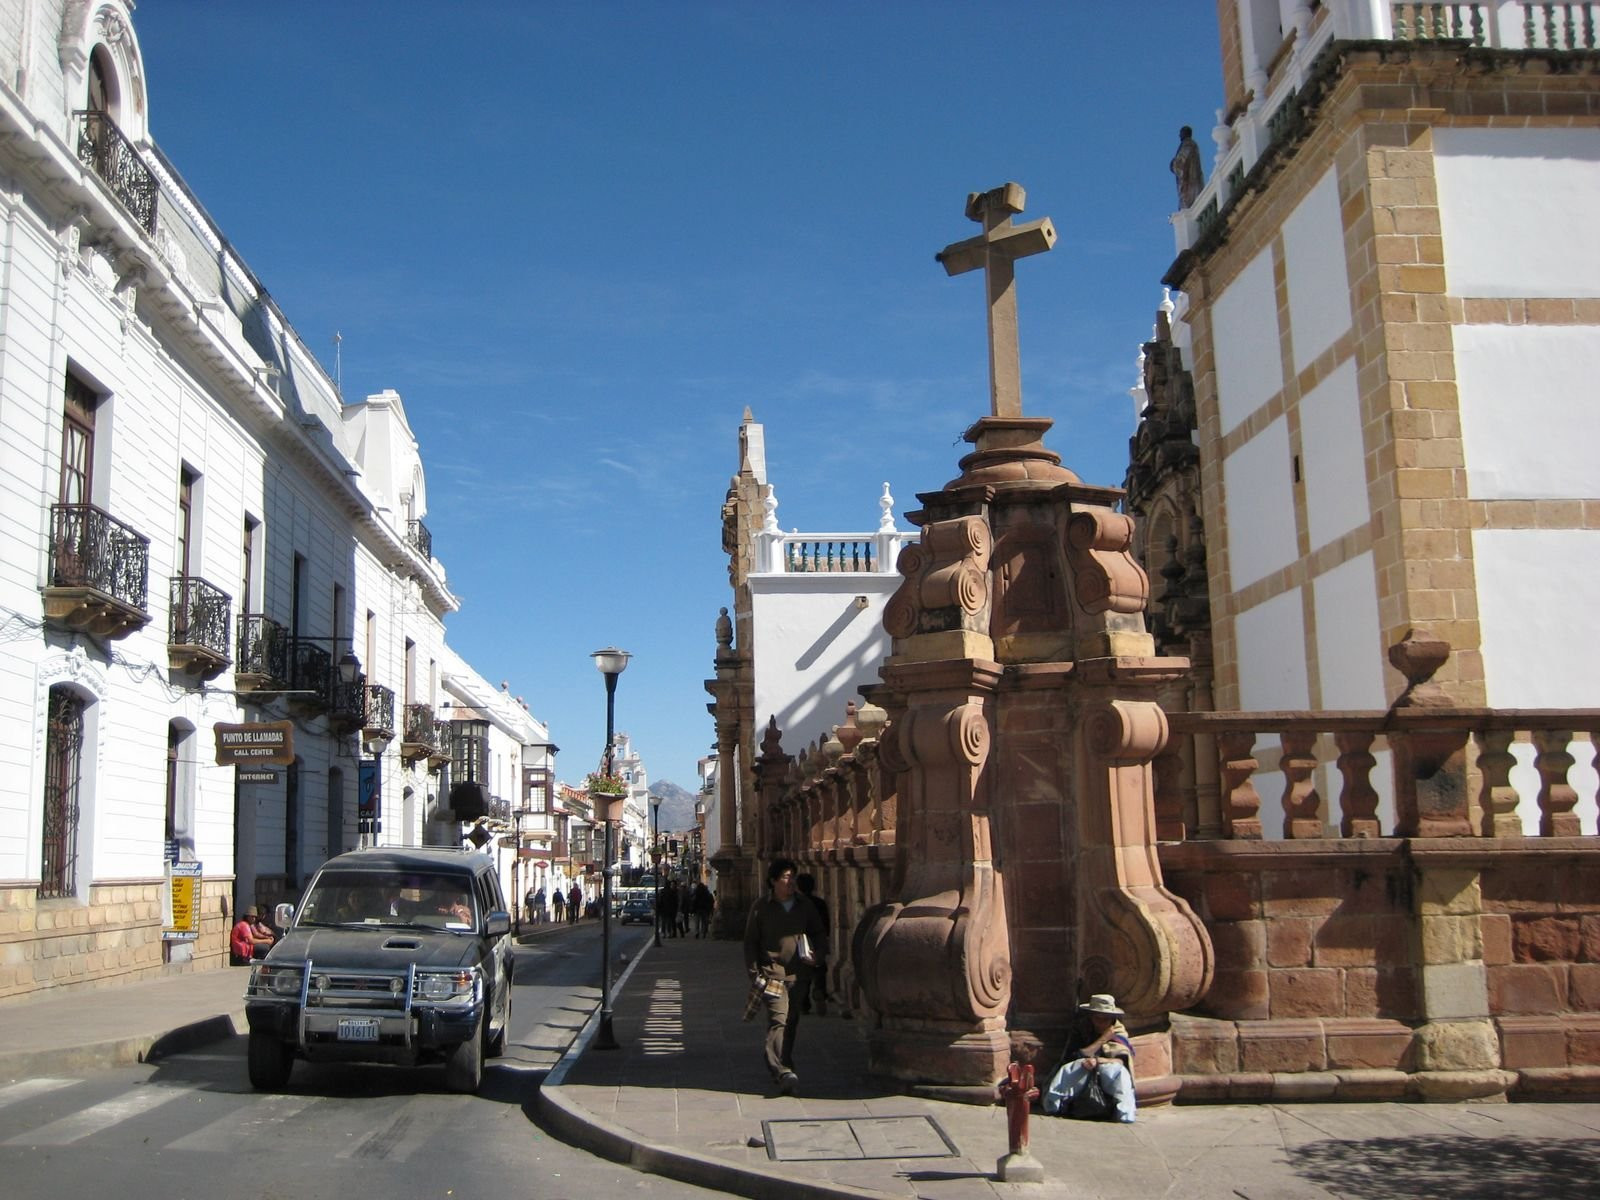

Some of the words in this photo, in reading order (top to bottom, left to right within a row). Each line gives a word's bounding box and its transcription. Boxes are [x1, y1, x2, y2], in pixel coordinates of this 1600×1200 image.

[223, 732, 243, 743] PUNTO
[244, 732, 252, 743] DE
[253, 732, 284, 742] LLAMADAS
